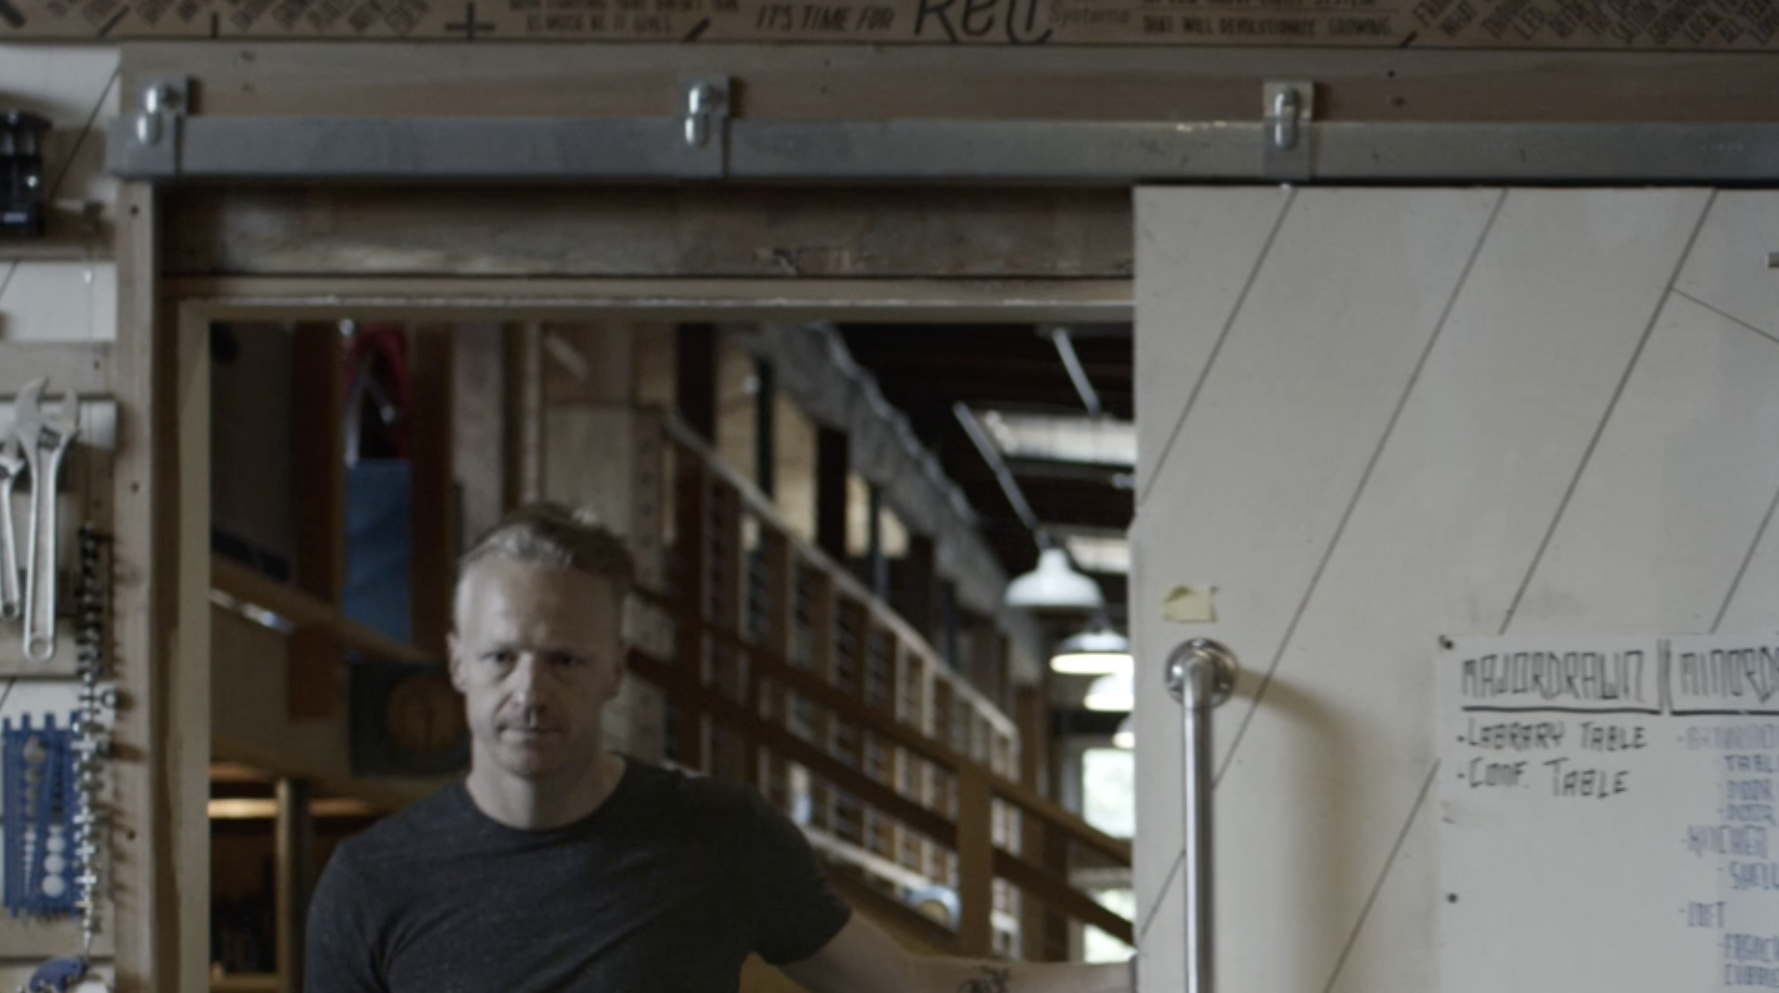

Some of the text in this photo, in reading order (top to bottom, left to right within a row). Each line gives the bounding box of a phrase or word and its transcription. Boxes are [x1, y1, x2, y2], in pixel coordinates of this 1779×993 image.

[755, 4, 895, 32] IT'S TIME FOR
[1462, 650, 1646, 703] MAJORDRAWN
[1580, 720, 1647, 752] TABLE
[1542, 757, 1630, 799] TABLE
